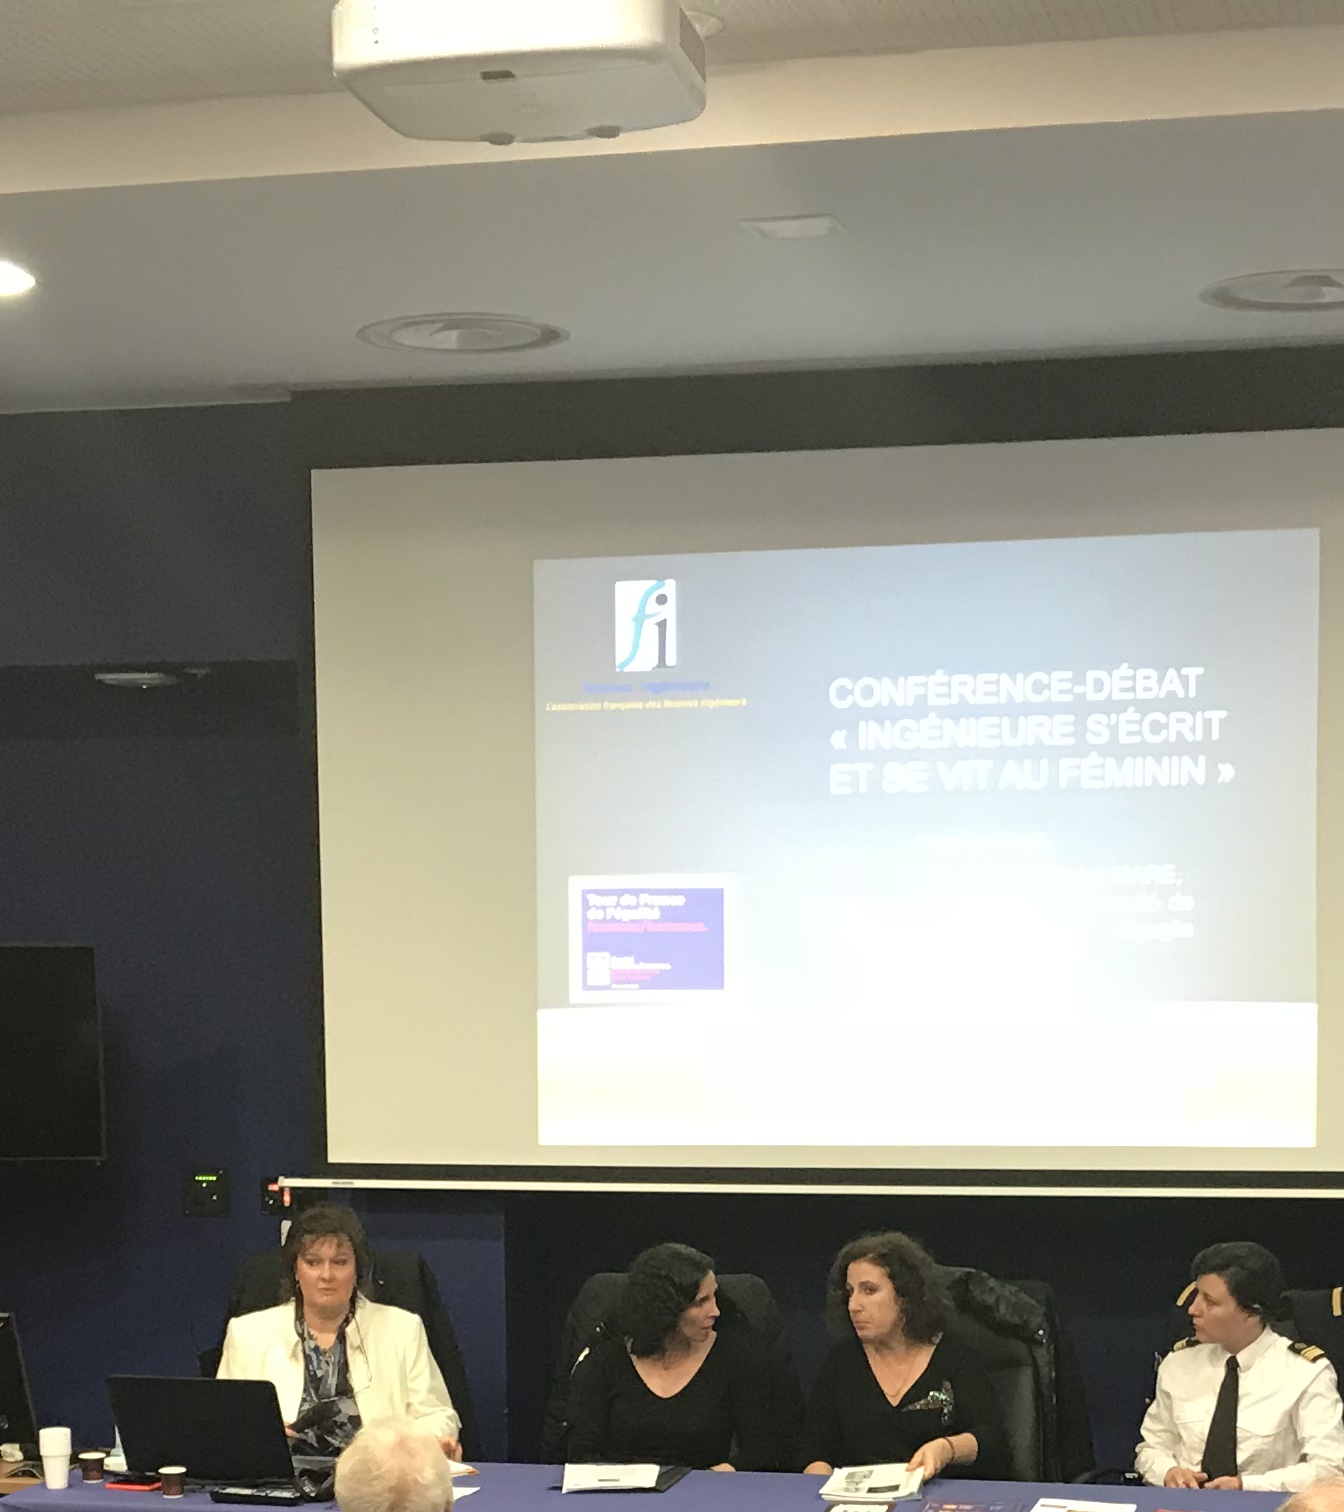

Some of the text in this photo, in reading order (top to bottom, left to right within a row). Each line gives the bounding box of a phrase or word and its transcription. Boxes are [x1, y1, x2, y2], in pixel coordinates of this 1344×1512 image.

[829, 663, 1204, 708] CONFÉRENCE-DÉBAT
[858, 713, 1076, 750] INGÉNIEURE
[1086, 706, 1228, 745] S'ÉCRIT
[829, 762, 875, 795] ET
[881, 761, 929, 794] SE
[937, 759, 994, 792] VIT
[998, 758, 1049, 791] AU
[1058, 752, 1206, 790] FÉMININ
